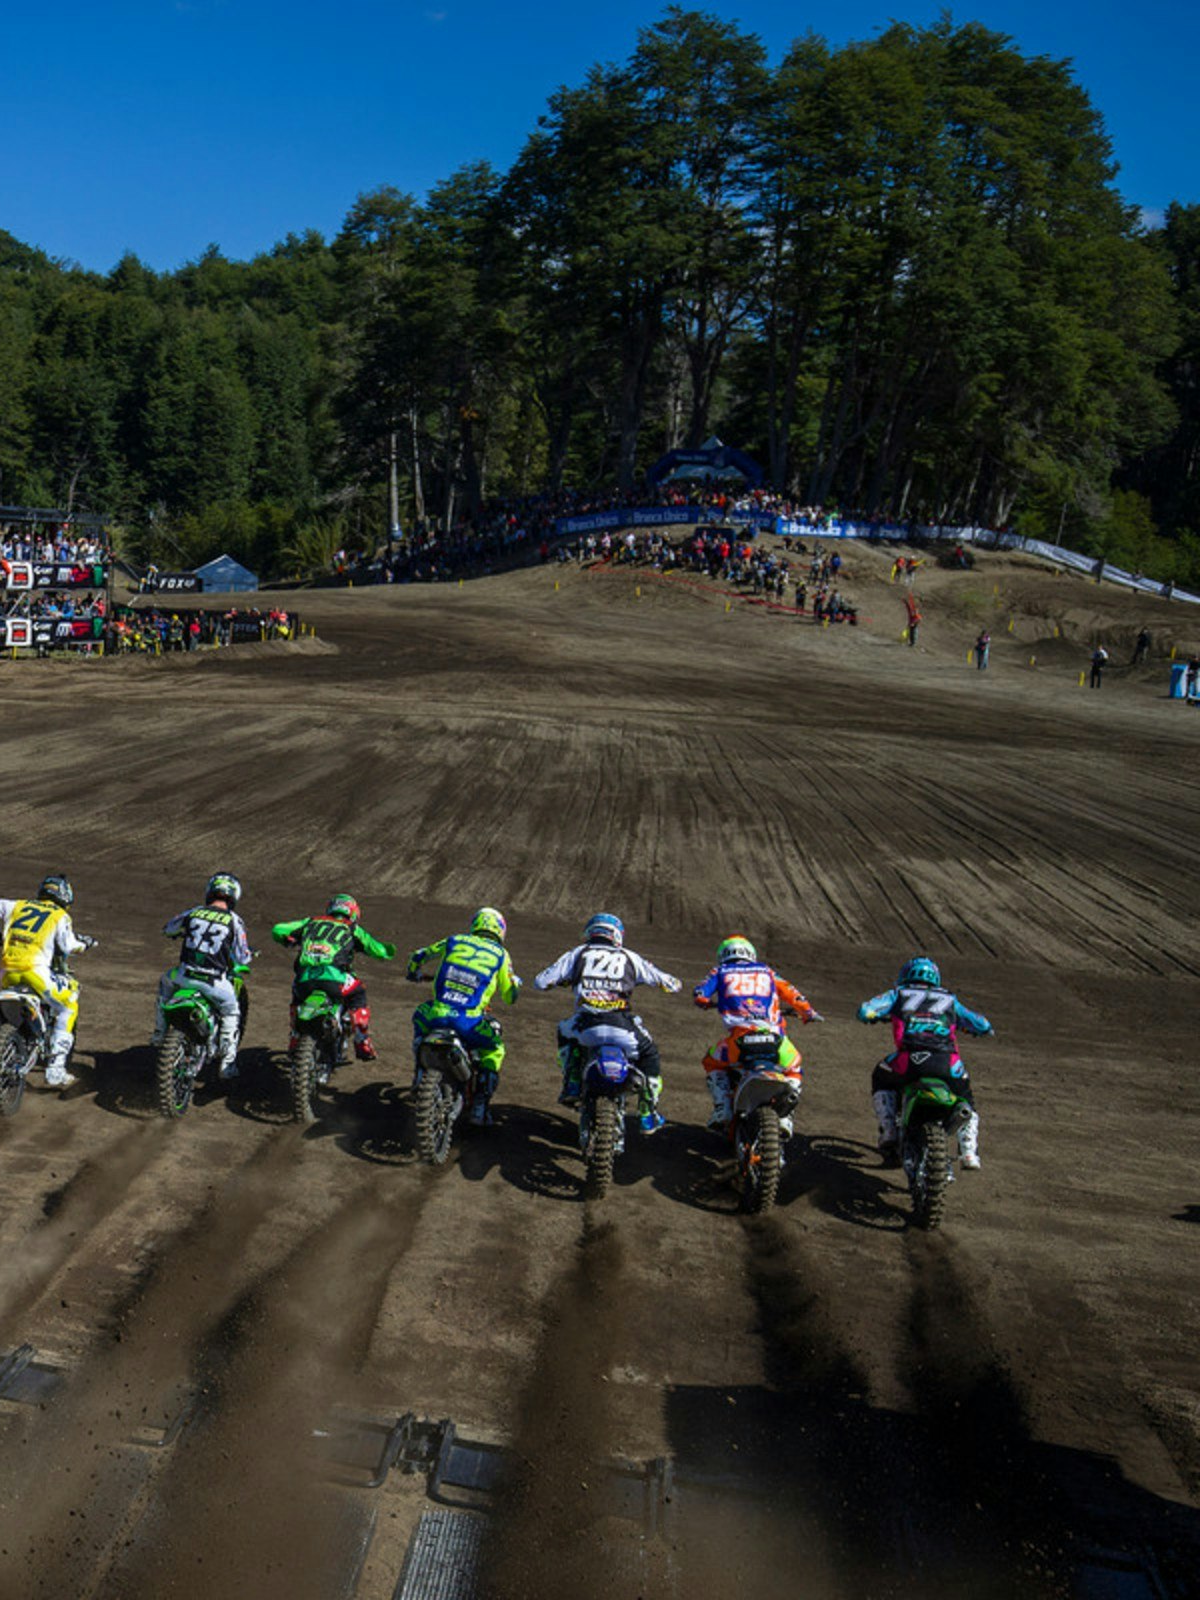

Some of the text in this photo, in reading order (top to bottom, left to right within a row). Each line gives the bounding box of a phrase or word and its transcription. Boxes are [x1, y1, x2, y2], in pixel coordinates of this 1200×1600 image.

[159, 578, 184, 589] FOX
[10, 906, 51, 933] 21
[186, 918, 229, 955] 33
[446, 943, 499, 976] 22
[581, 949, 627, 979] 128
[582, 978, 623, 992] YAMAHA
[900, 989, 953, 1014] 77
